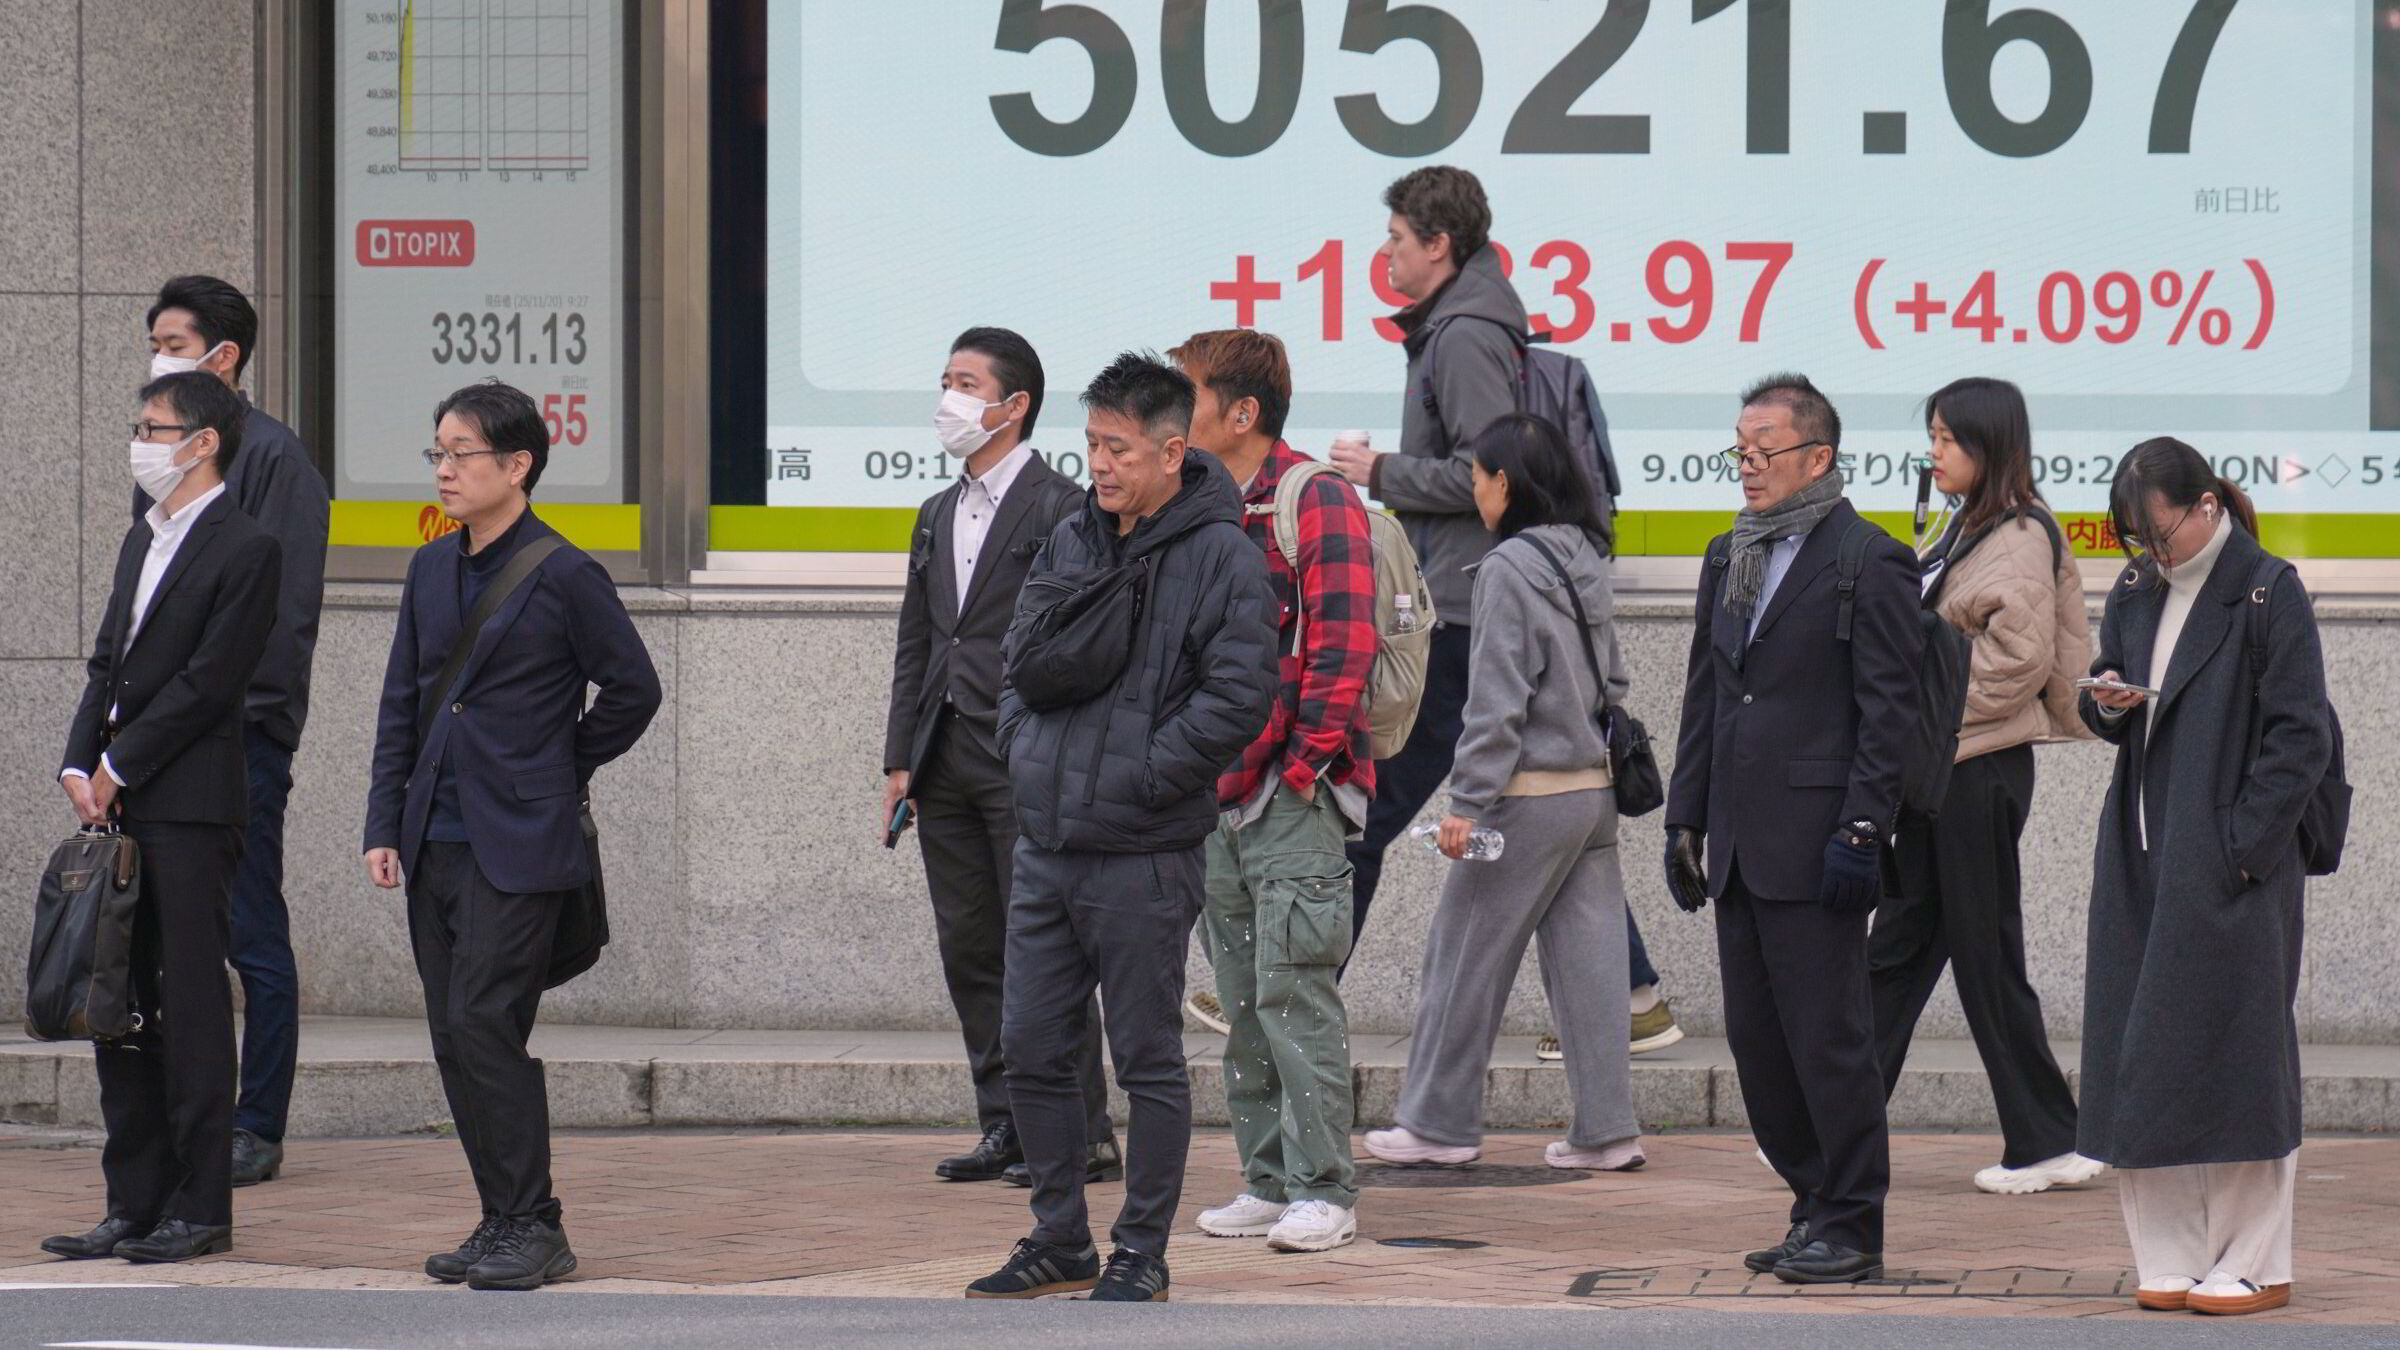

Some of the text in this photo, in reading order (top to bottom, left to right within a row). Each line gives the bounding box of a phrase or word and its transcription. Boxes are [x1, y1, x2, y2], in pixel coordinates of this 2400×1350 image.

[989, 0, 2238, 158] 50521.67
[427, 172, 576, 183] 10 11 13 14 15
[2194, 187, 2280, 214] 前日比
[393, 231, 462, 257] TOPIX
[1853, 258, 2276, 350] (+4.09%)
[431, 311, 588, 365] 3331.13
[1642, 454, 1740, 483] 9.0%
